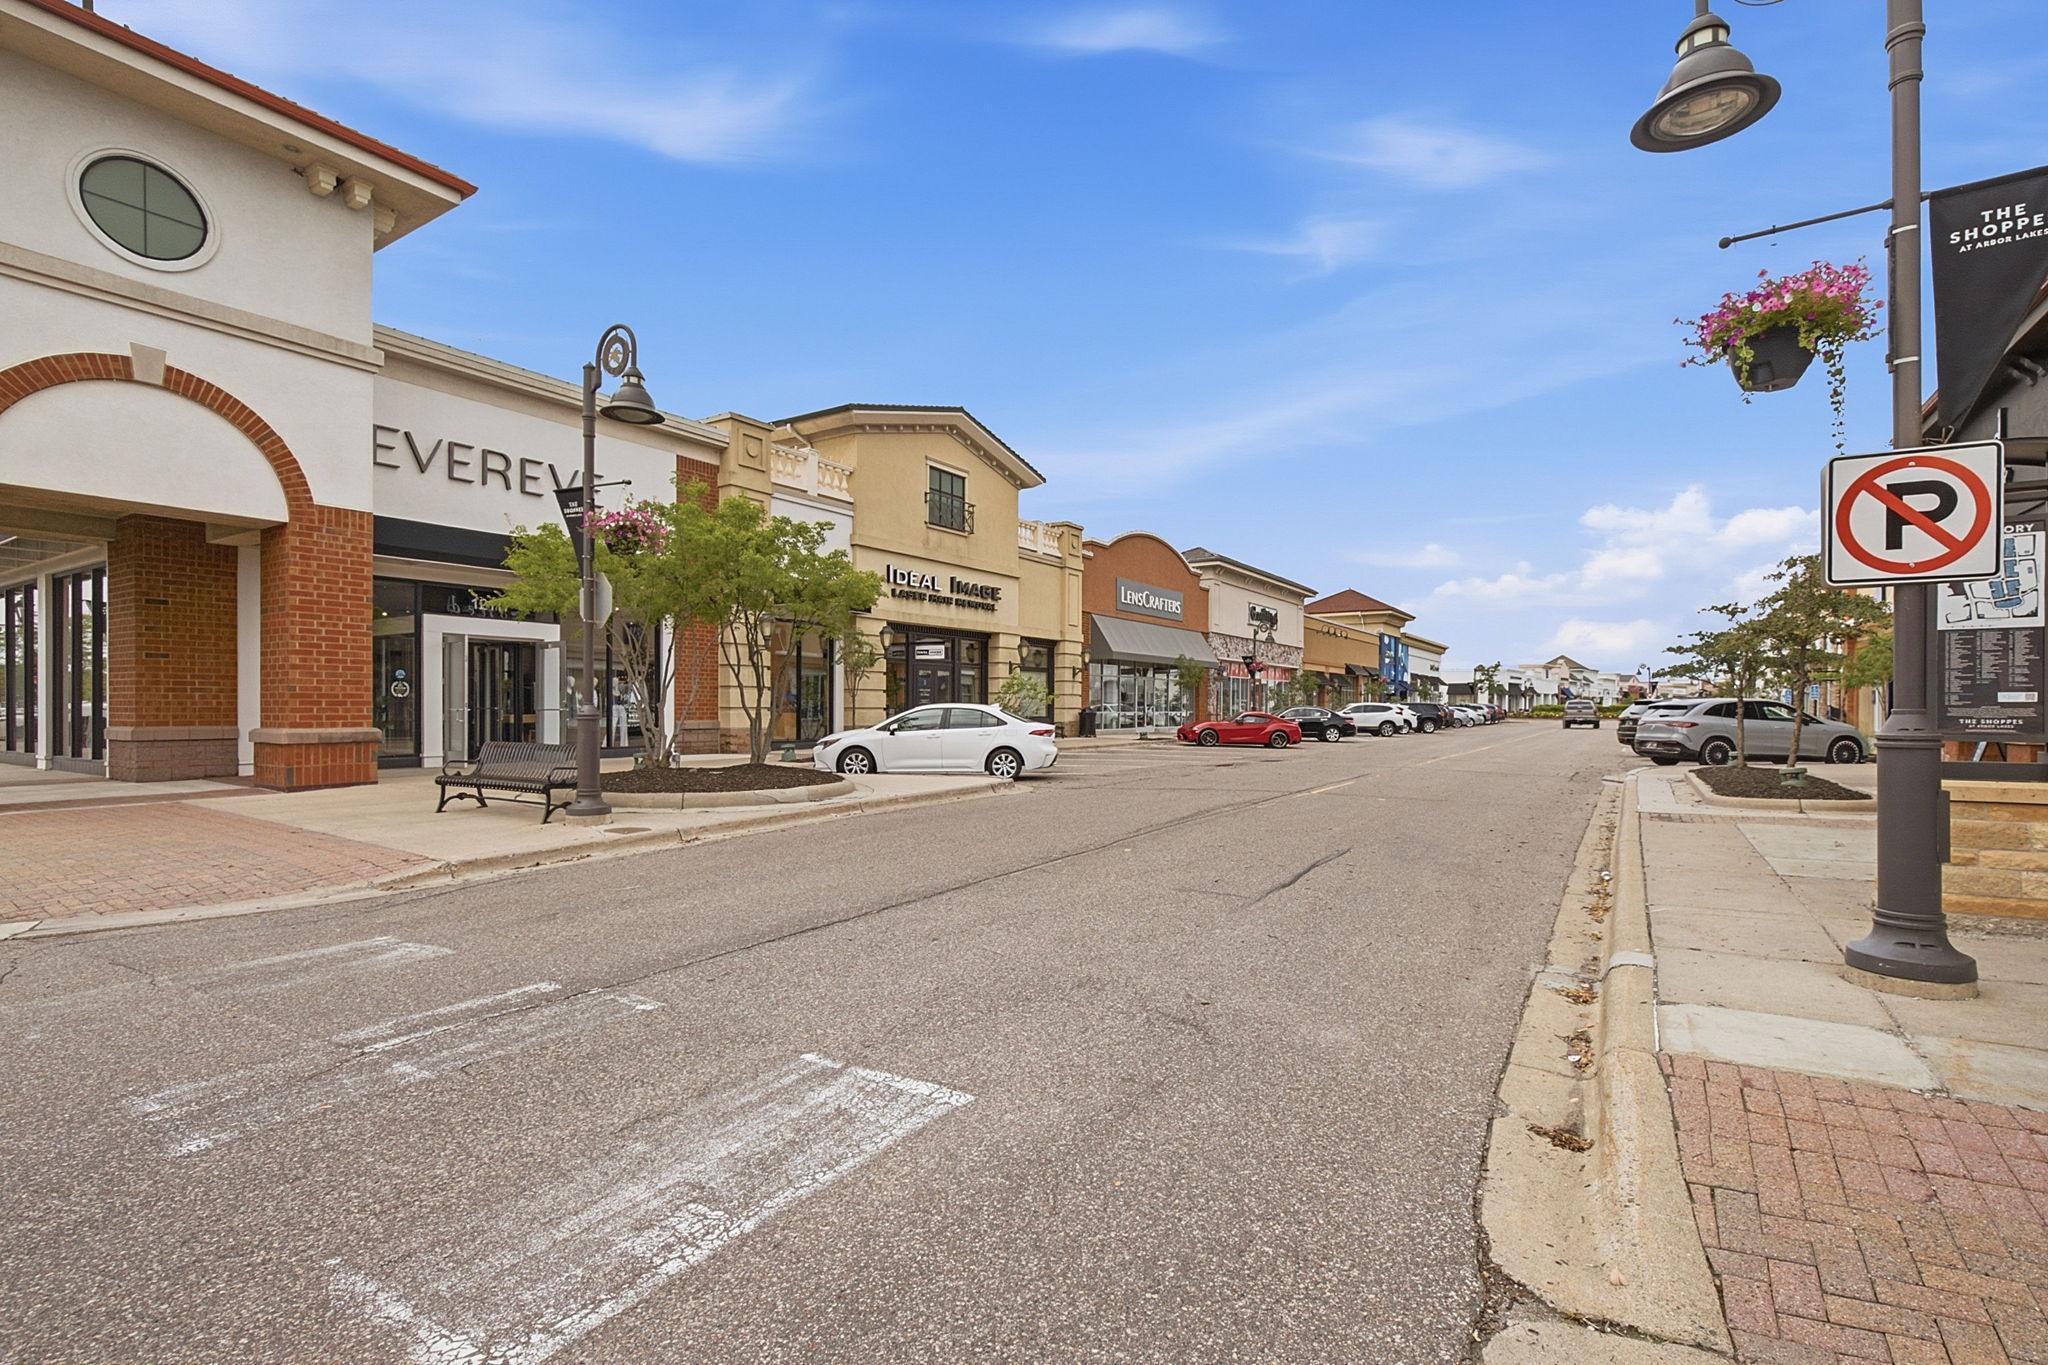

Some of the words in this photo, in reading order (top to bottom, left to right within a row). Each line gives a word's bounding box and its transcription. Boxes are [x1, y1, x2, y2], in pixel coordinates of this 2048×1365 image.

[1981, 203, 2027, 223] THE
[1949, 213, 2048, 244] SHOPPE
[1959, 243, 1973, 253] AT
[1975, 235, 2012, 249] ARBOR
[2015, 228, 2048, 241] LAKES
[886, 563, 943, 592] IDEAL
[950, 576, 1002, 602] IMAGE
